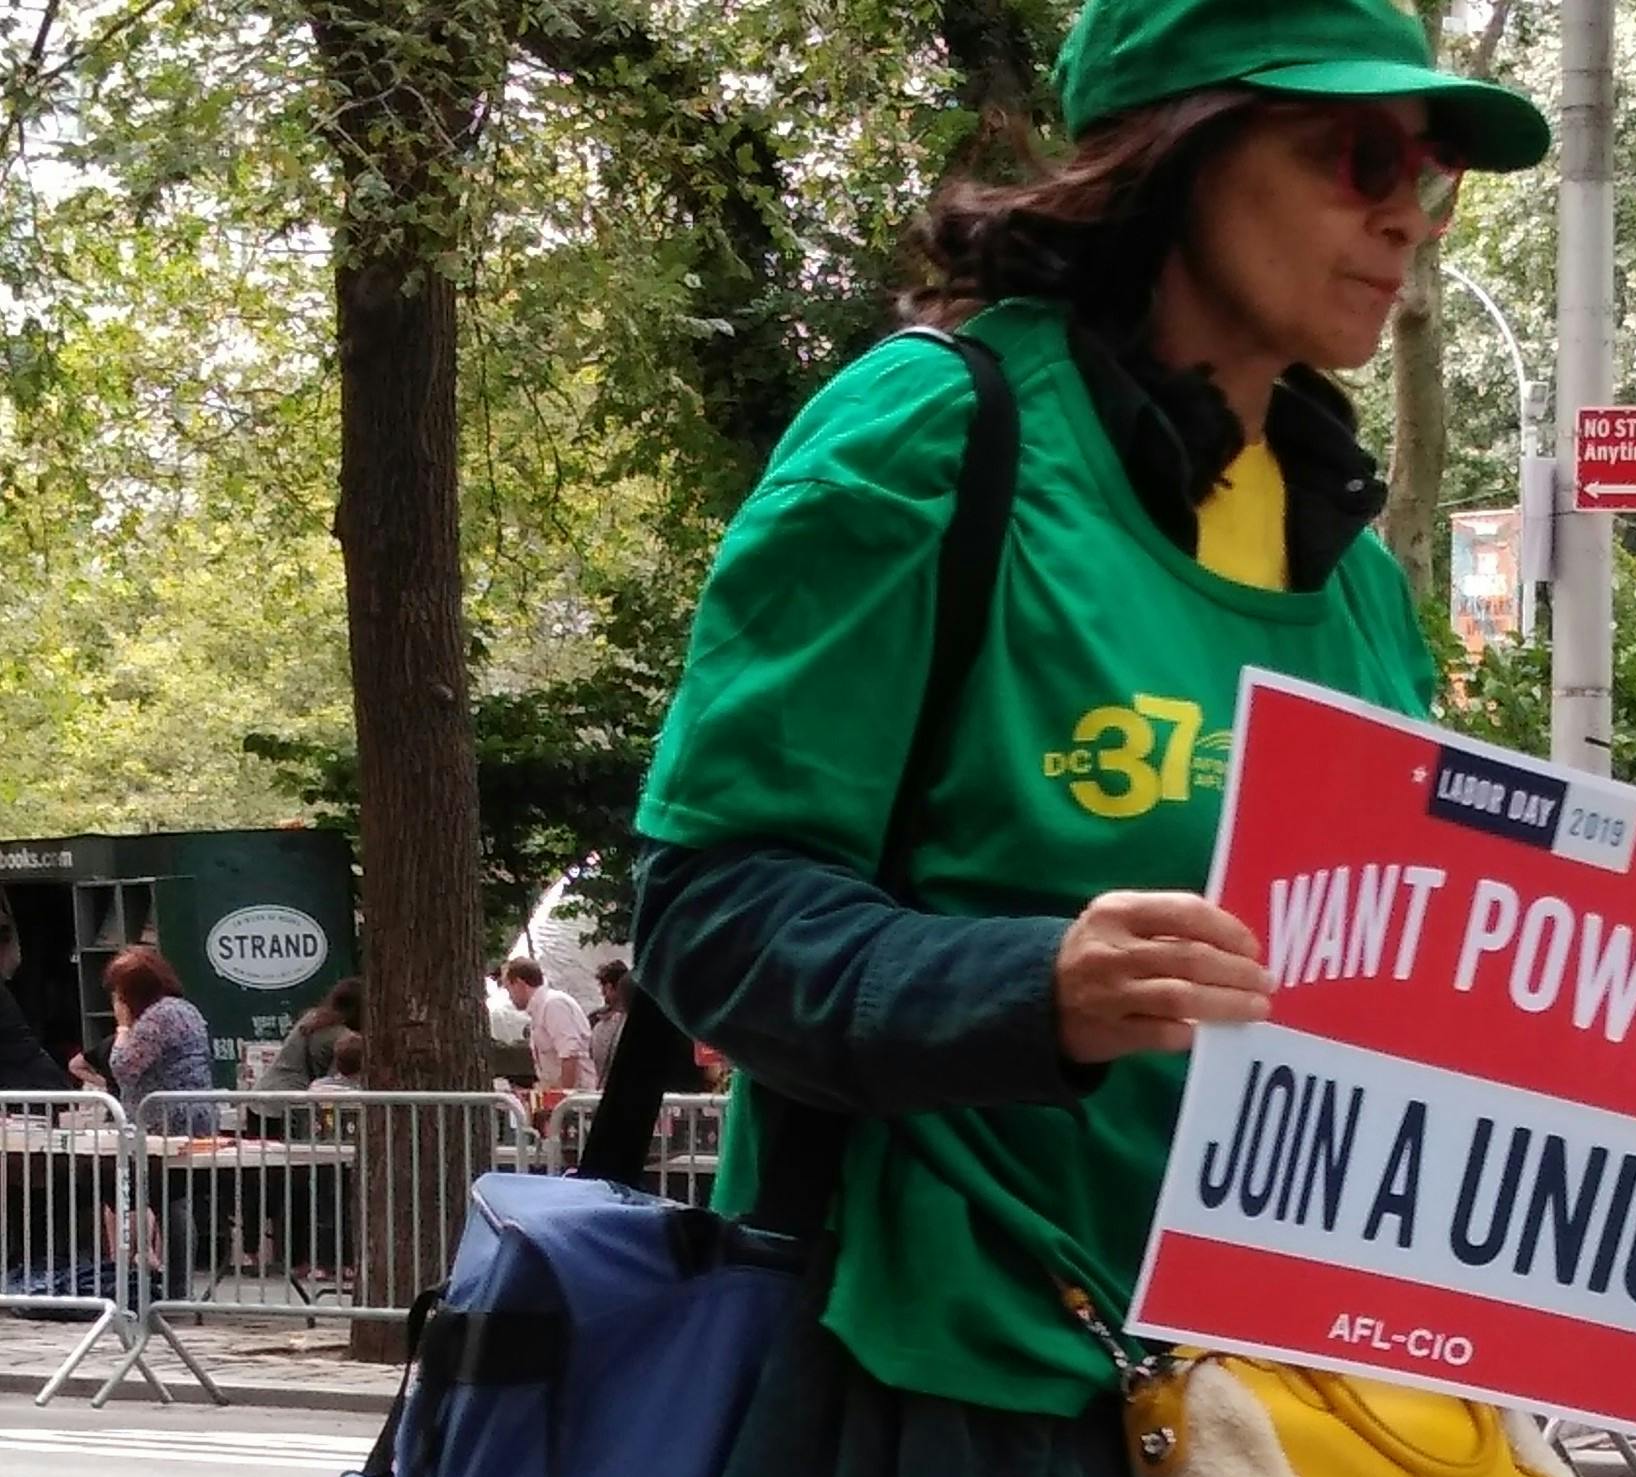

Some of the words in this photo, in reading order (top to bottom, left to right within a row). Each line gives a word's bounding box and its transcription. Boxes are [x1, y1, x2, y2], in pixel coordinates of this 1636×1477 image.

[1583, 418, 1610, 438] NO
[1044, 750, 1092, 777] DC
[1070, 693, 1202, 818] 37
[1437, 769, 1505, 814] LABOR
[1507, 790, 1556, 827] DAY
[1569, 808, 1625, 846] 2019
[218, 934, 318, 960] STRAND
[1269, 864, 1446, 989] WANT
[1200, 1060, 1364, 1233] JOIN
[1363, 1101, 1428, 1249] A
[1327, 1312, 1474, 1366] AFL-CIO
